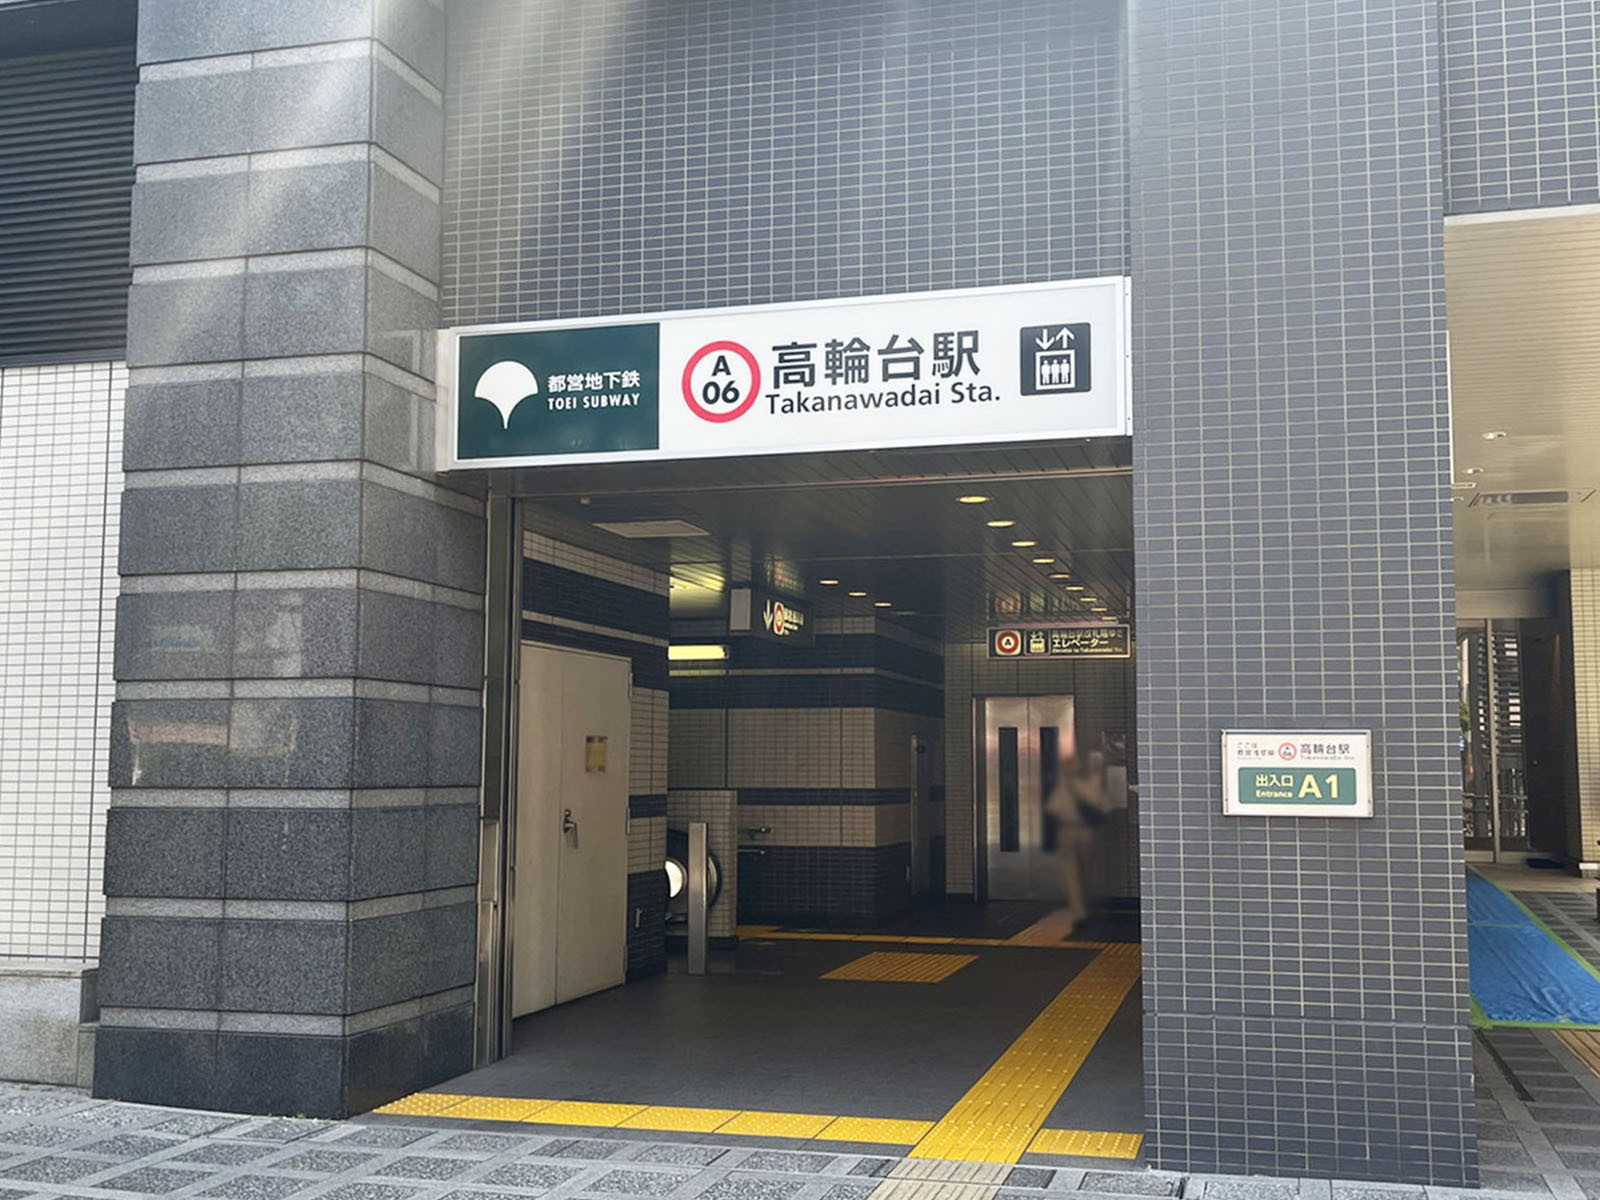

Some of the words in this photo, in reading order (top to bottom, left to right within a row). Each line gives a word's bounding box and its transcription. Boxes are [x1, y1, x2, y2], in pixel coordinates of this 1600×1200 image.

[711, 354, 732, 377] A
[771, 329, 982, 390] 高輪台駅
[547, 369, 641, 393] 都営地下鉄
[702, 379, 741, 405] 06
[547, 396, 578, 411] TOEI
[583, 392, 641, 409] SUBWAY
[764, 382, 941, 415] Takanawadai
[950, 381, 1001, 404] Sta.
[1052, 638, 1109, 648] エレベーター
[1256, 773, 1294, 787] 出入口
[1297, 773, 1339, 799] A1
[1255, 789, 1294, 798] Entrance
